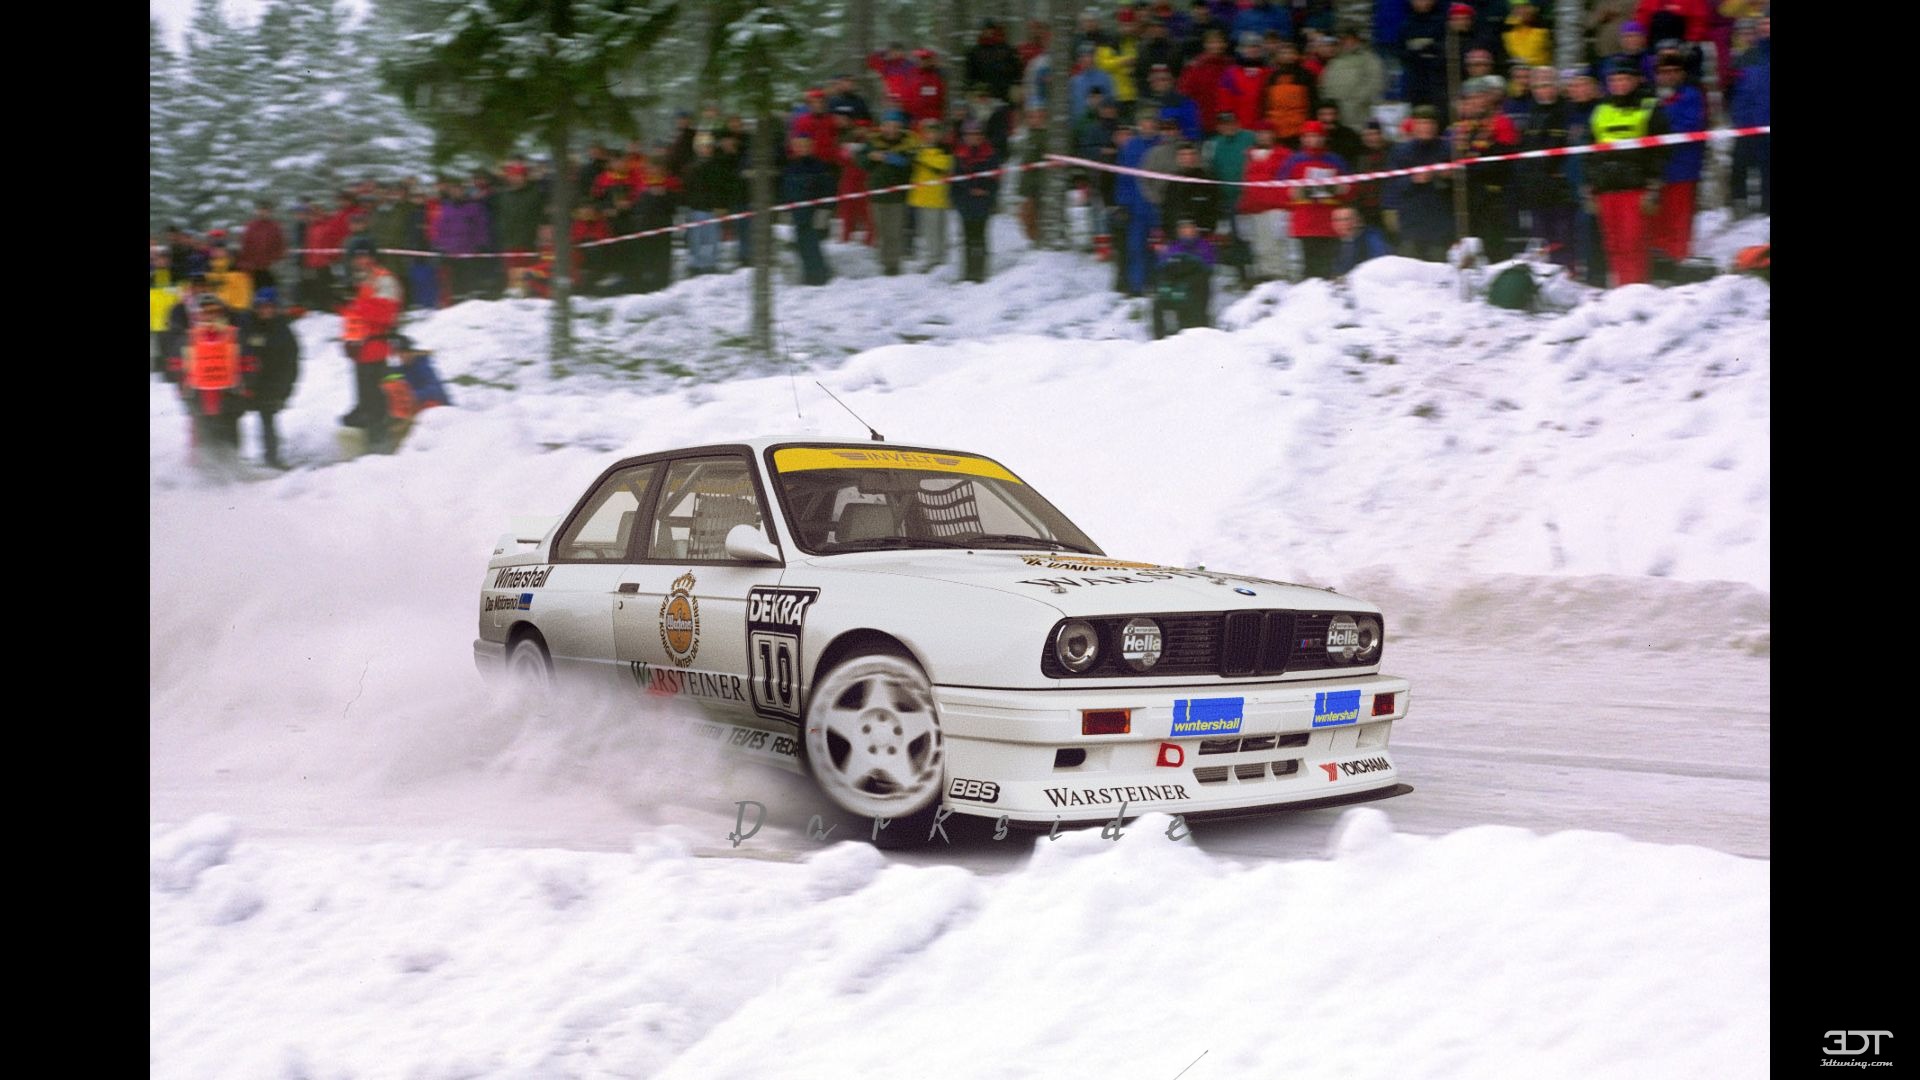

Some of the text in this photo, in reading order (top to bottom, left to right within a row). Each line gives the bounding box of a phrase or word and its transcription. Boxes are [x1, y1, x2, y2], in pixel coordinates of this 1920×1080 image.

[494, 566, 555, 589] Wintershall
[749, 593, 810, 626] DEKRA
[1123, 634, 1161, 652] Hella
[1327, 630, 1359, 645] Hella
[630, 660, 746, 702] WARSTEINER
[759, 640, 792, 708] 10
[1174, 717, 1241, 733] wintershall
[1314, 708, 1359, 723] wintershall
[727, 726, 770, 750] TEVES
[1337, 757, 1392, 777] YOKOHAMA
[950, 778, 1000, 803] BBS
[1043, 784, 1191, 808] WARSTEINER
